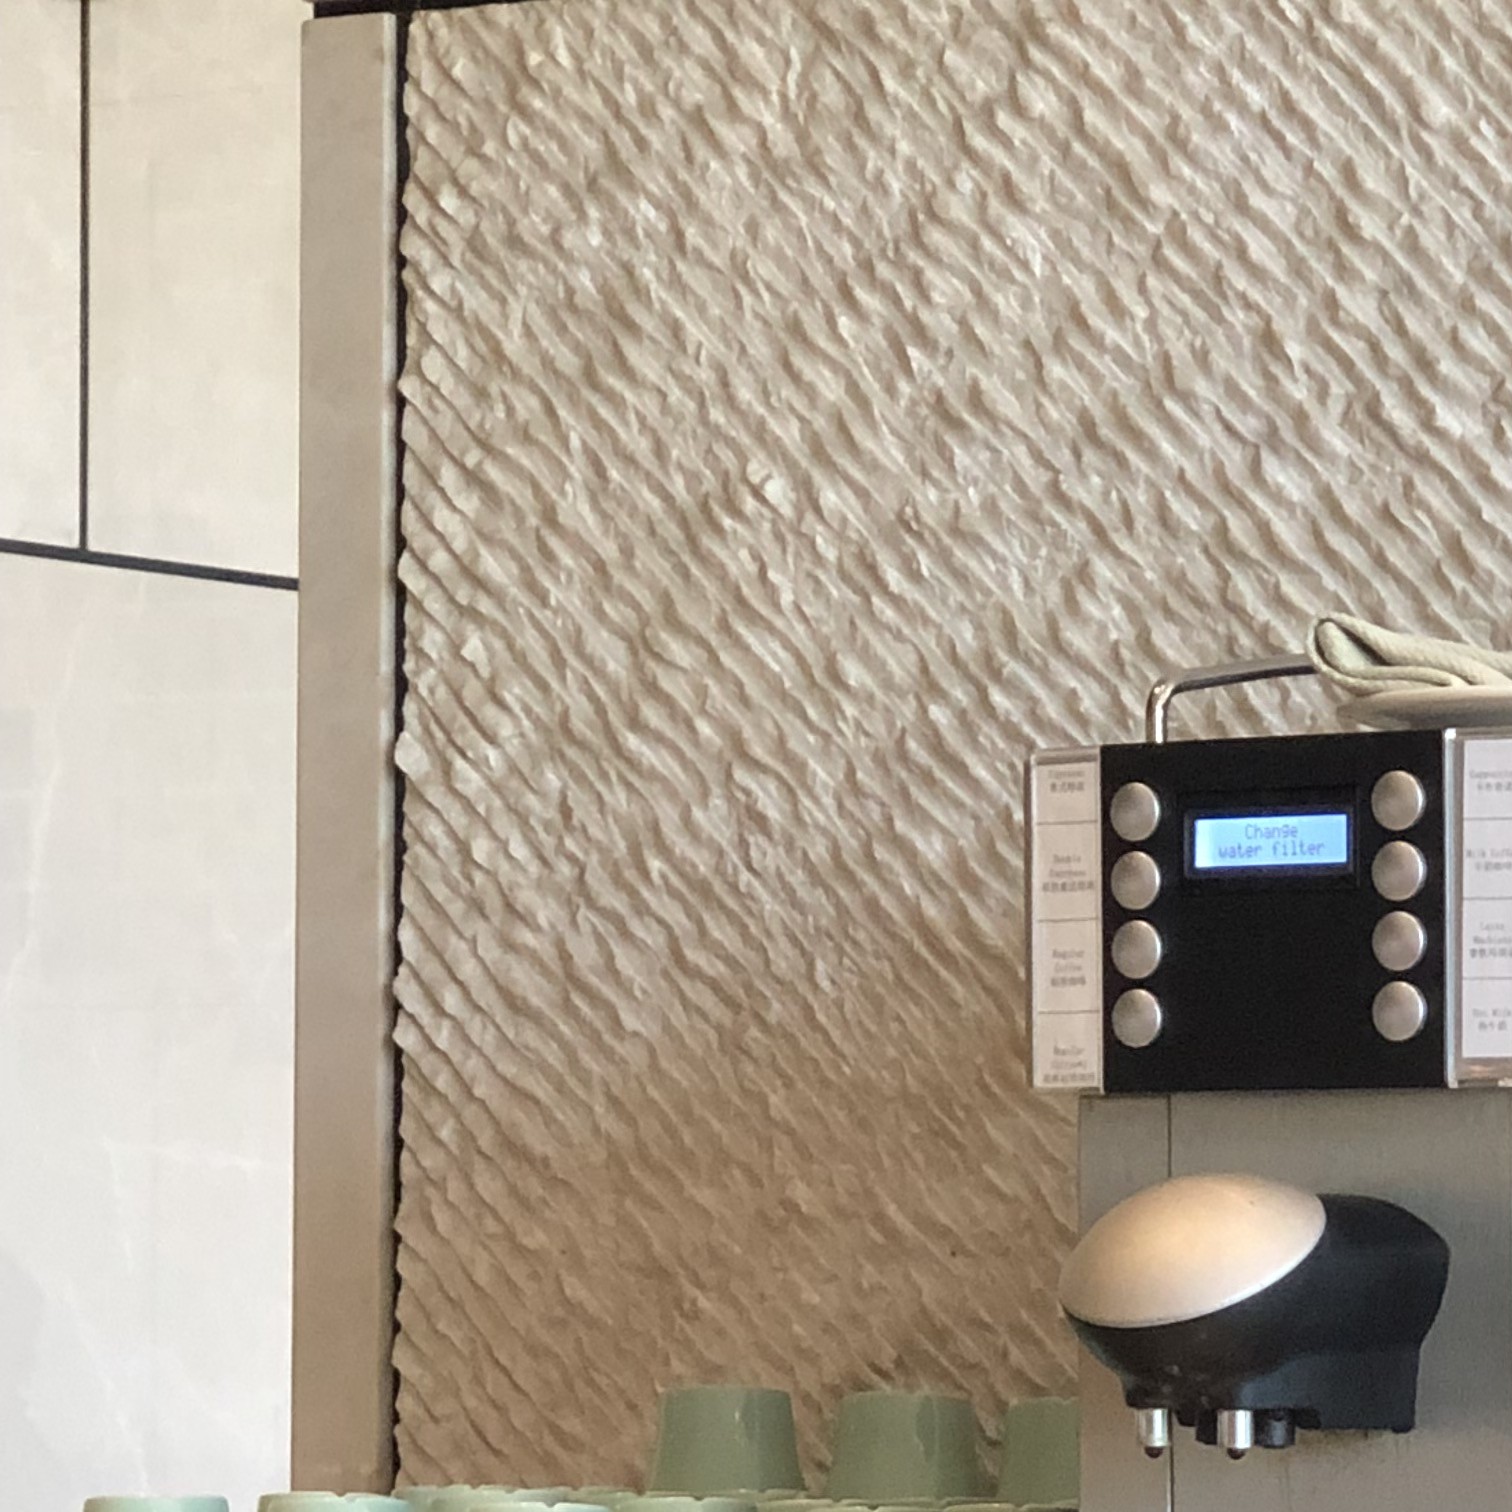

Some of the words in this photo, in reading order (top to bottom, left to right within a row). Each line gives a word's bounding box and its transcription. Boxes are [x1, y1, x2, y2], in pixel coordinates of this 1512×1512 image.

[1244, 823, 1299, 840] Change
[1218, 843, 1263, 859] water
[1272, 840, 1325, 857] filter
